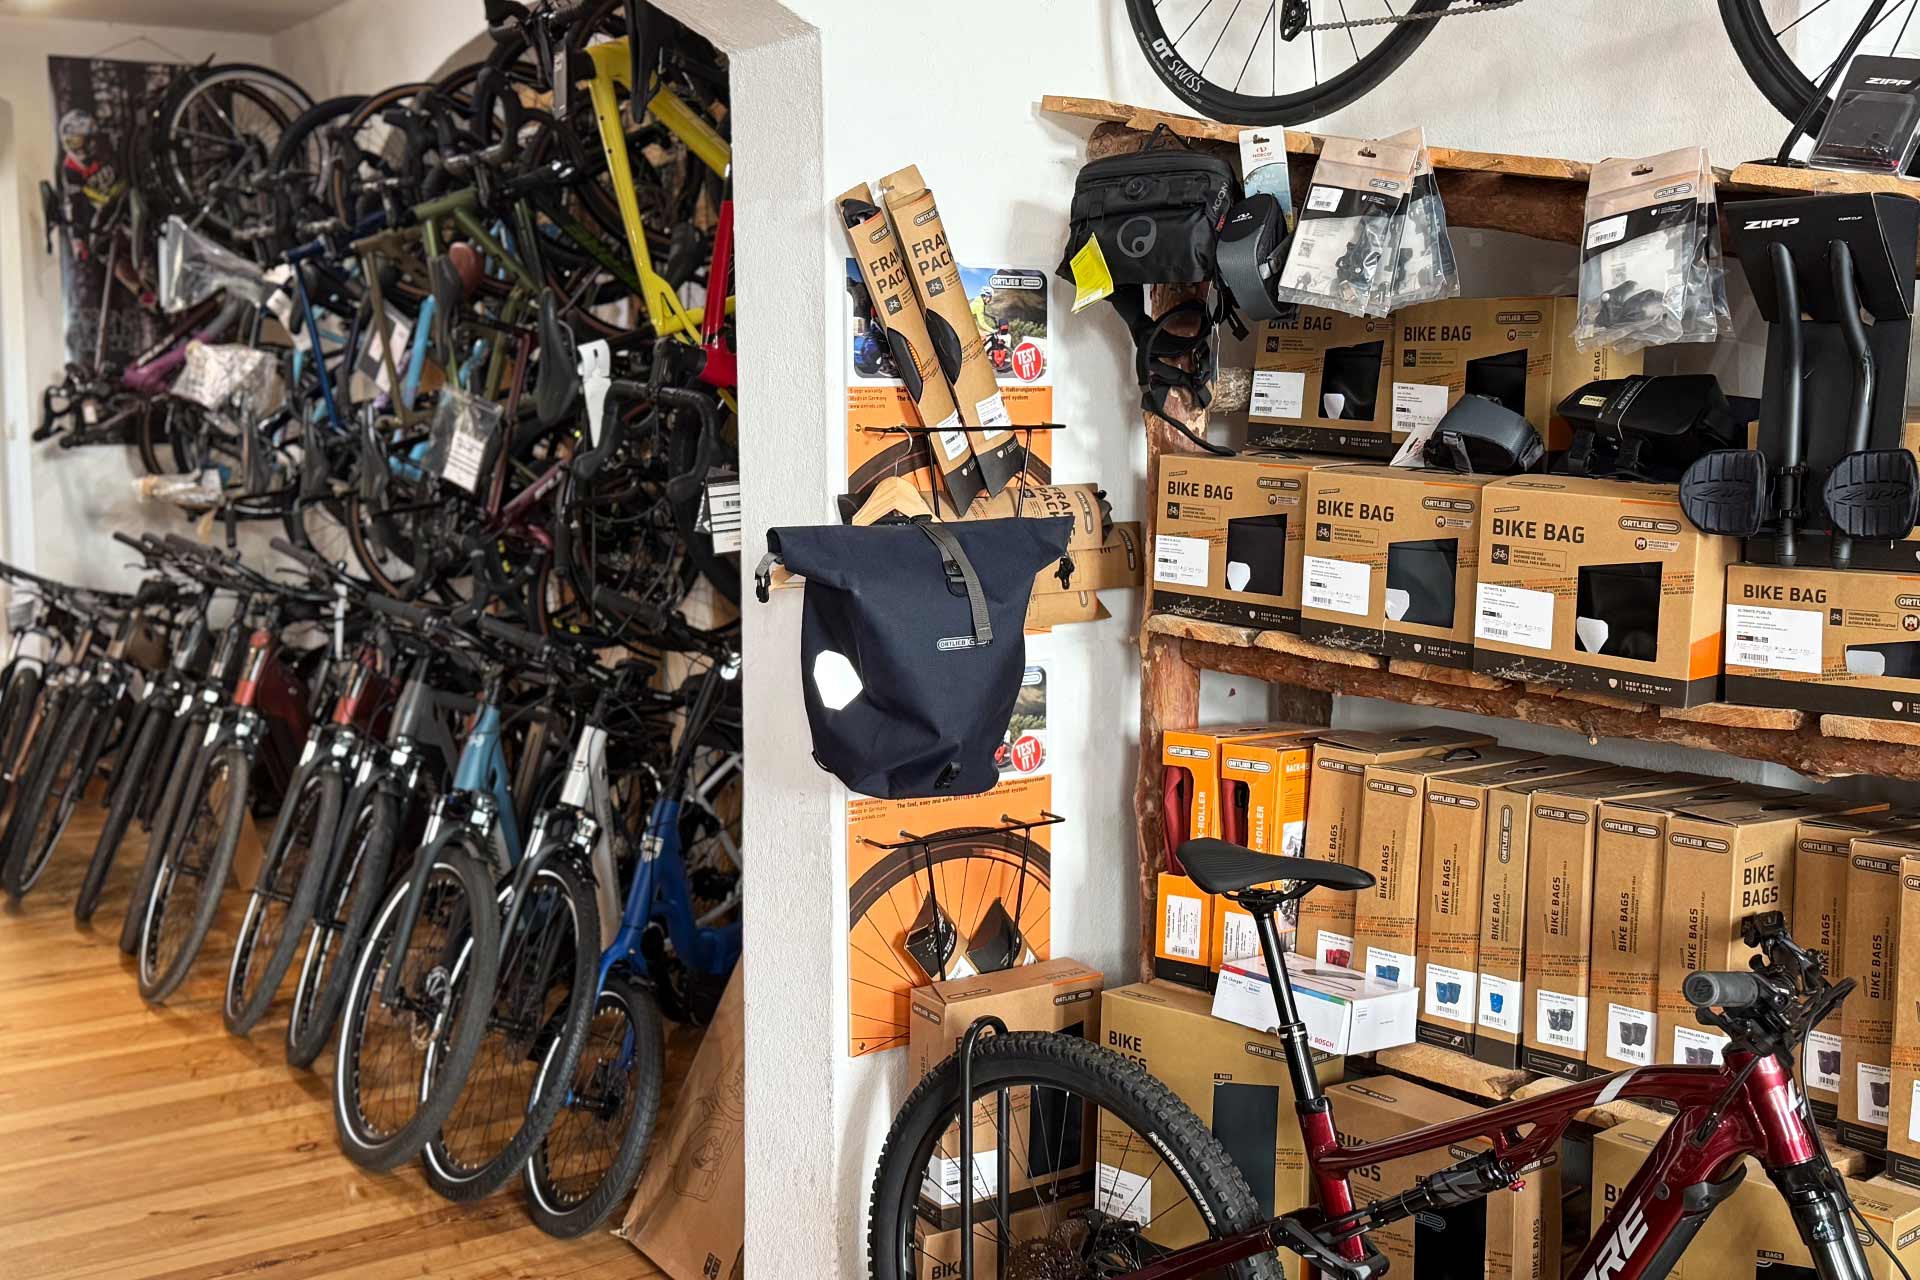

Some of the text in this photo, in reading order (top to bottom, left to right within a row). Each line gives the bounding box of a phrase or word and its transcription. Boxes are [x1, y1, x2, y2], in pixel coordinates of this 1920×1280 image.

[1152, 38, 1174, 60] DT
[1168, 60, 1205, 92] SWISS
[1865, 77, 1912, 86] ZIPP
[1744, 218, 1800, 230] ZIPP
[1303, 316, 1332, 331] BAG
[1403, 326, 1471, 341] BIKE BAG
[1016, 347, 1036, 364] TEST
[1022, 362, 1035, 379] IT!
[1167, 481, 1233, 500] BIKE BAG
[1048, 487, 1074, 516] FRA
[1317, 499, 1394, 522] BIKE BAG
[1425, 500, 1450, 508] ORTLIEB
[1493, 518, 1585, 544] BIKE BAG
[1622, 519, 1653, 529] ORTLIEB
[1744, 584, 1827, 603] BIKE BAG
[1016, 739, 1036, 758] TEST
[1022, 755, 1035, 772] IT!
[1320, 760, 1345, 770] ORTLIEB
[1370, 782, 1394, 792] ORTLIEB
[1430, 793, 1456, 804] ORTLIEB
[1537, 808, 1565, 818] ORTLIEB
[1329, 824, 1338, 849] BAGS
[1605, 822, 1633, 832] ORTLIEB
[1672, 836, 1702, 847] ORTLIEB
[1802, 842, 1833, 852] ORTLIEB
[1380, 844, 1390, 899] BIKE BAGS
[1855, 858, 1887, 870] ORTLIEB
[1744, 864, 1775, 885] BIKE
[1441, 858, 1451, 914] BIKE BAGS
[1551, 876, 1561, 934] BIKE BAGS
[1742, 886, 1778, 907] BAGS
[1491, 894, 1501, 940] BIKE BAG
[1618, 892, 1629, 952] BIKE BAGS
[1687, 908, 1698, 970] BIKE BAGS
[1821, 914, 1830, 946] BAGS
[1871, 935, 1882, 999] BIKE BAGS
[1109, 1031, 1142, 1052] BIKE
[1248, 1045, 1272, 1056] ORTLIEB
[1314, 1037, 1334, 1048] BOSCH
[1532, 1218, 1541, 1280] BIKE BAGS
